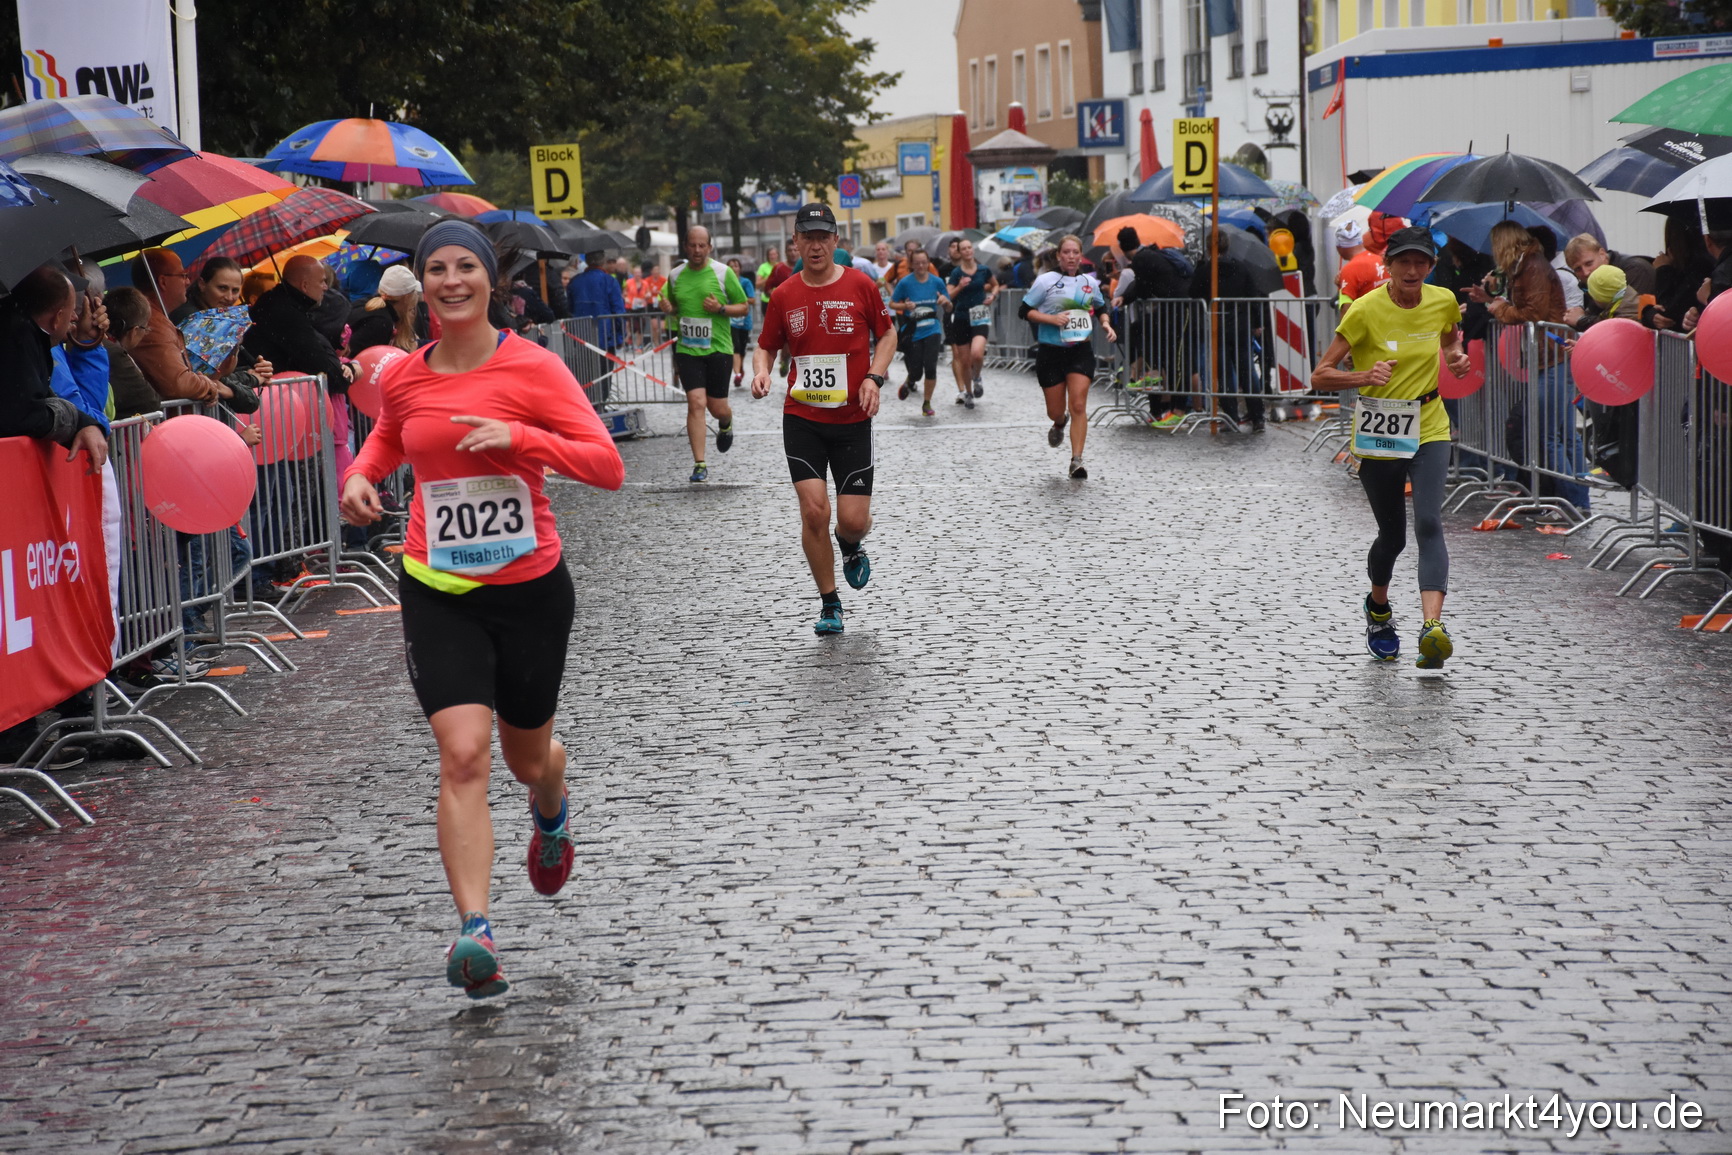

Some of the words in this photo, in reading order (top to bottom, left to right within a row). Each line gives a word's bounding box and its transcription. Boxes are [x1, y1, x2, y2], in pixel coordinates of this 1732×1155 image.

[1179, 120, 1214, 135] Block
[536, 148, 575, 162] Block
[1664, 140, 1706, 161] DORFNER
[1185, 141, 1207, 176] D
[545, 168, 570, 203] D
[682, 325, 709, 337] 3100
[791, 321, 804, 329] NEU
[803, 368, 836, 388] 335
[806, 393, 831, 402] Holger
[1361, 410, 1414, 435] 2287
[1376, 439, 1395, 448] Gabi
[467, 479, 519, 492] BOCK
[431, 490, 461, 499] NeuerMarkt
[436, 497, 524, 542] 2023
[451, 545, 515, 565] Elisabeth
